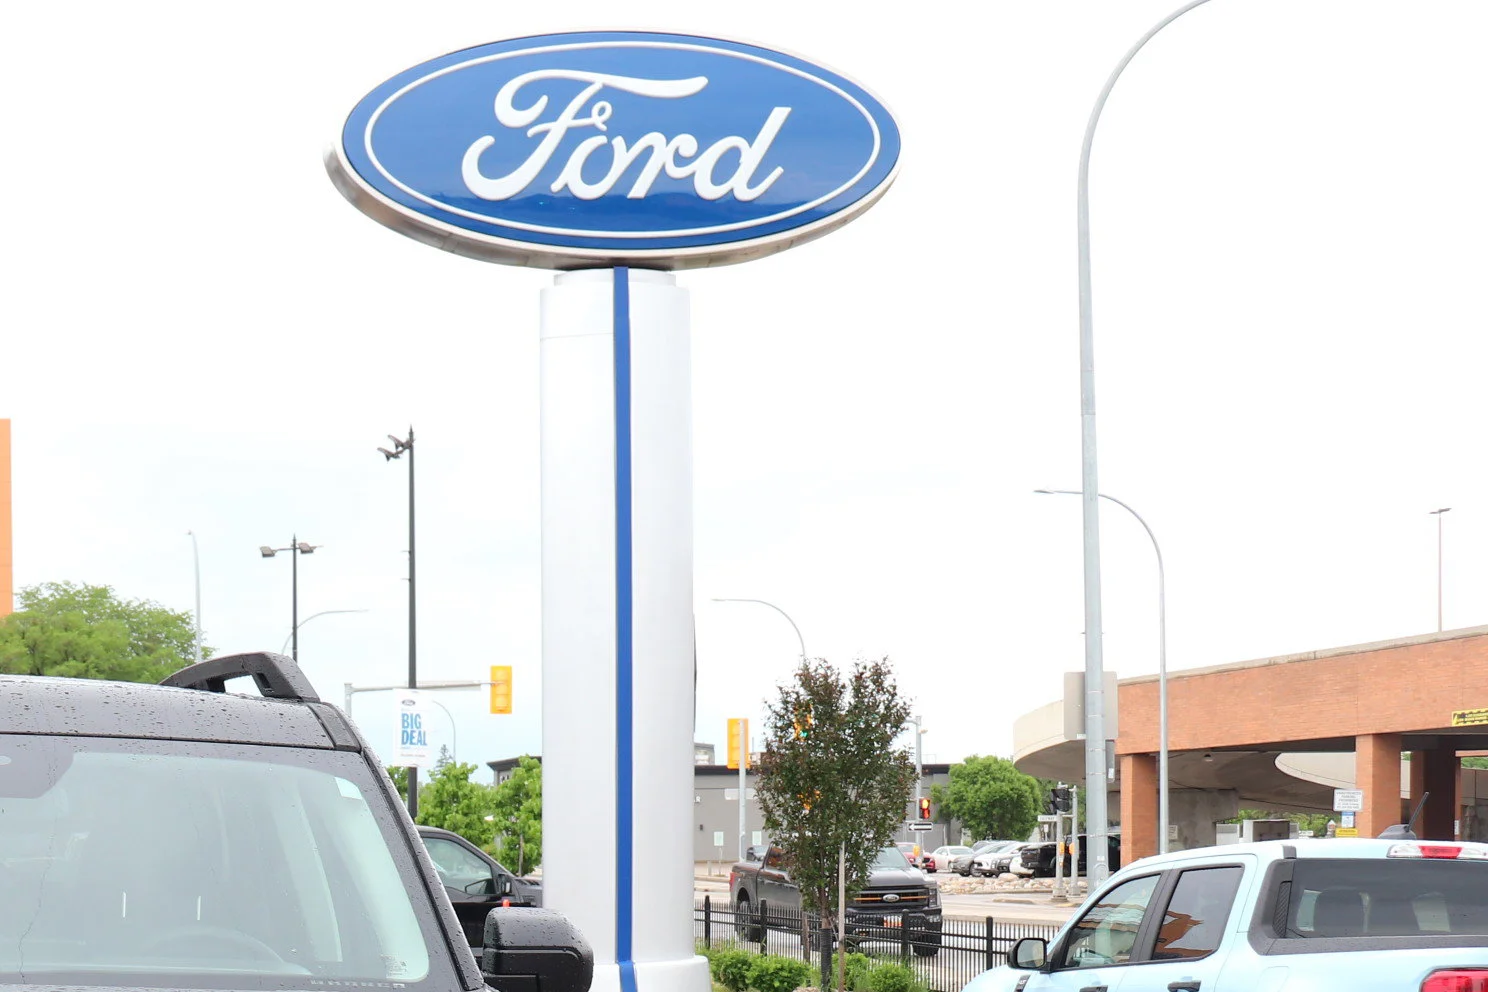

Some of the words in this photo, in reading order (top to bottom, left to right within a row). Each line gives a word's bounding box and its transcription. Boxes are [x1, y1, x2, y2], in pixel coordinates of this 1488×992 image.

[461, 68, 792, 202] Ford
[401, 712, 422, 730] BIG
[401, 730, 428, 746] DEAL
